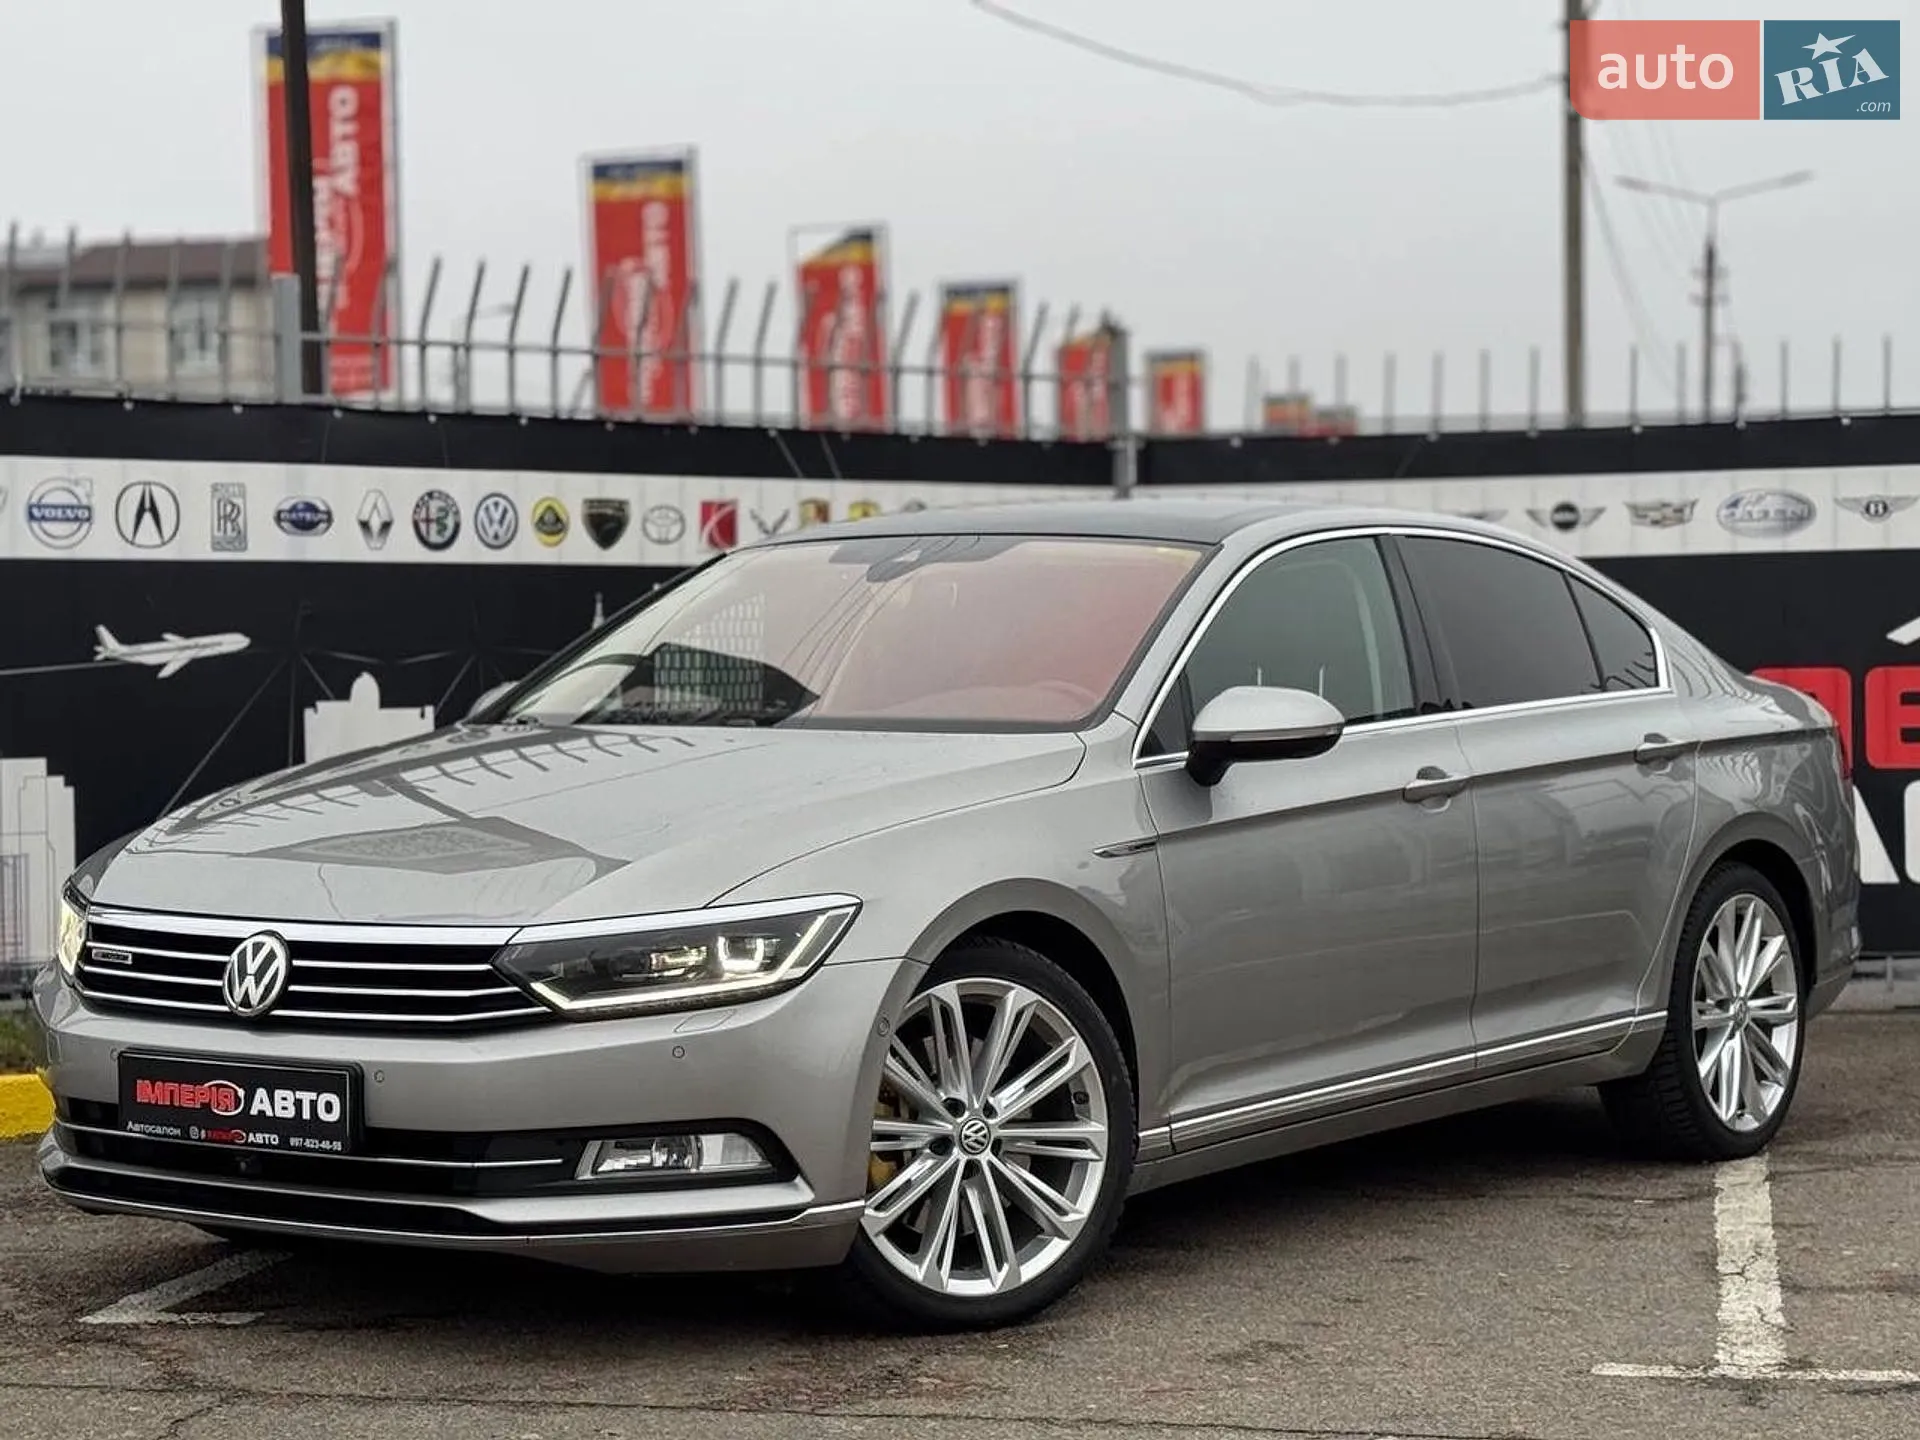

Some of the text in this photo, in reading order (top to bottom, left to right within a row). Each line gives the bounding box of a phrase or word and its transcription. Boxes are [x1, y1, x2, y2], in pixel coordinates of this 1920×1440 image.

[31, 506, 90, 519] VOLVO
[249, 1087, 341, 1123] АВТО
[126, 1120, 182, 1137] Автосалон
